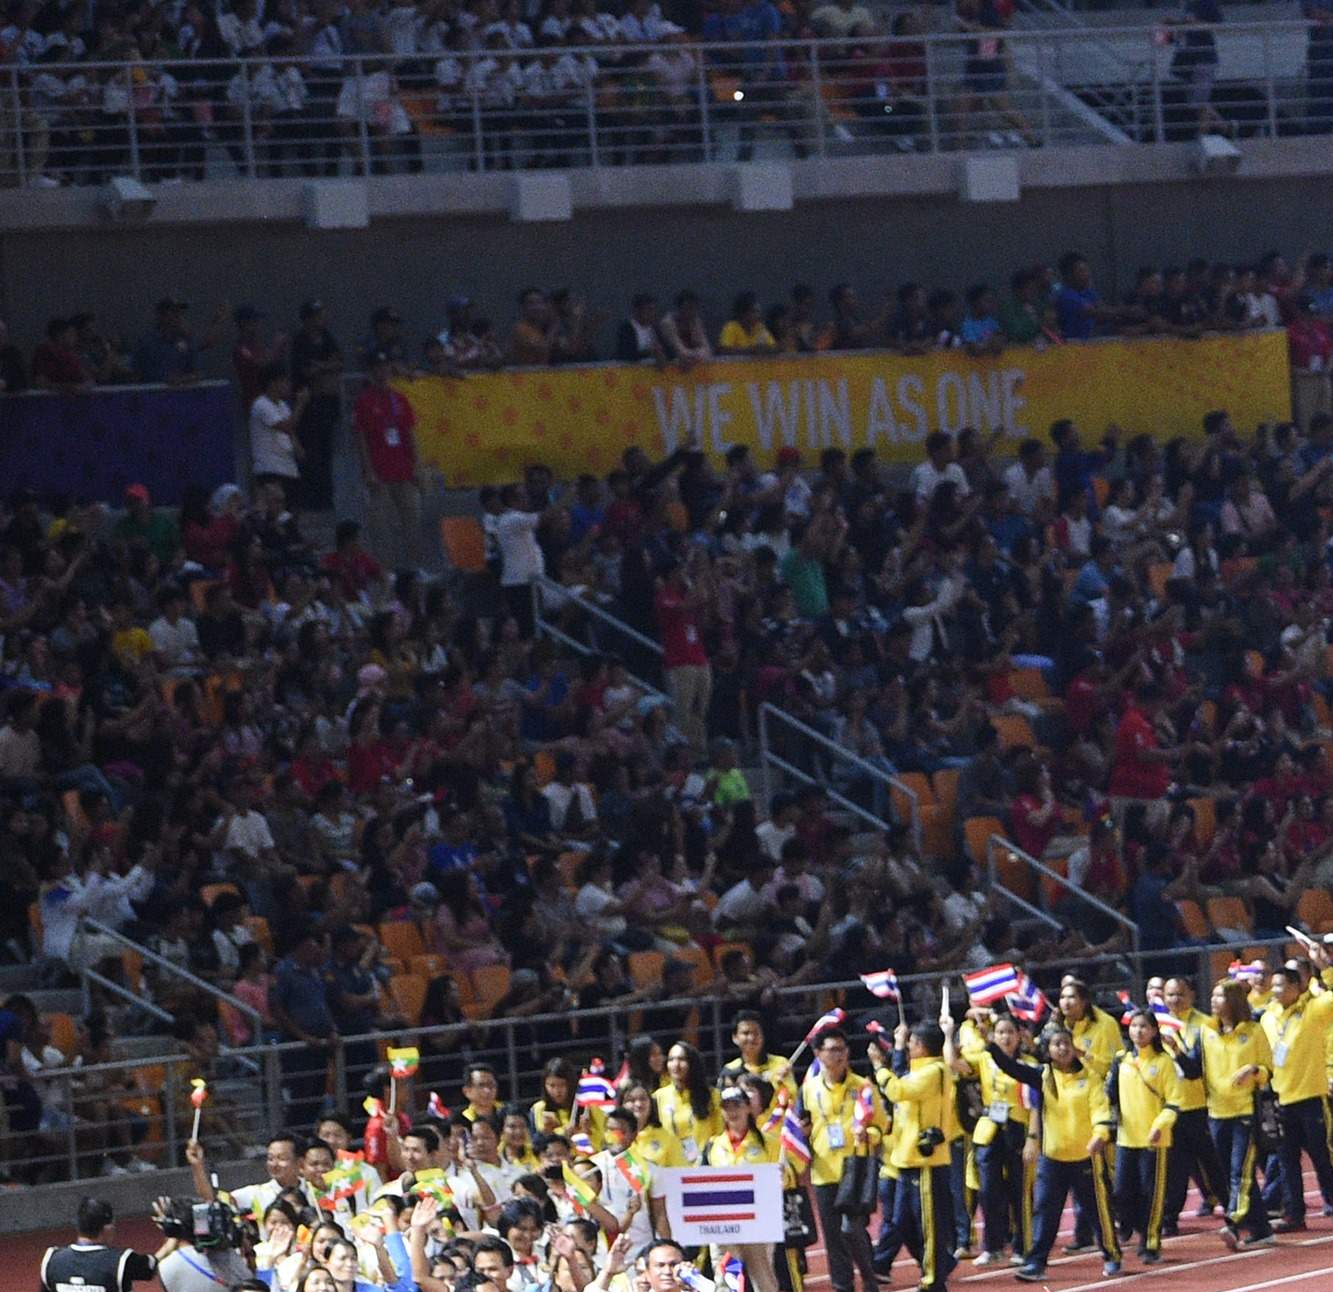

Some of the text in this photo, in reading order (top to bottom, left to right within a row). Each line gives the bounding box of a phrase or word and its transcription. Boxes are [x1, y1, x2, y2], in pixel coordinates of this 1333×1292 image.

[650, 367, 1031, 456] WE WIN AS ONE
